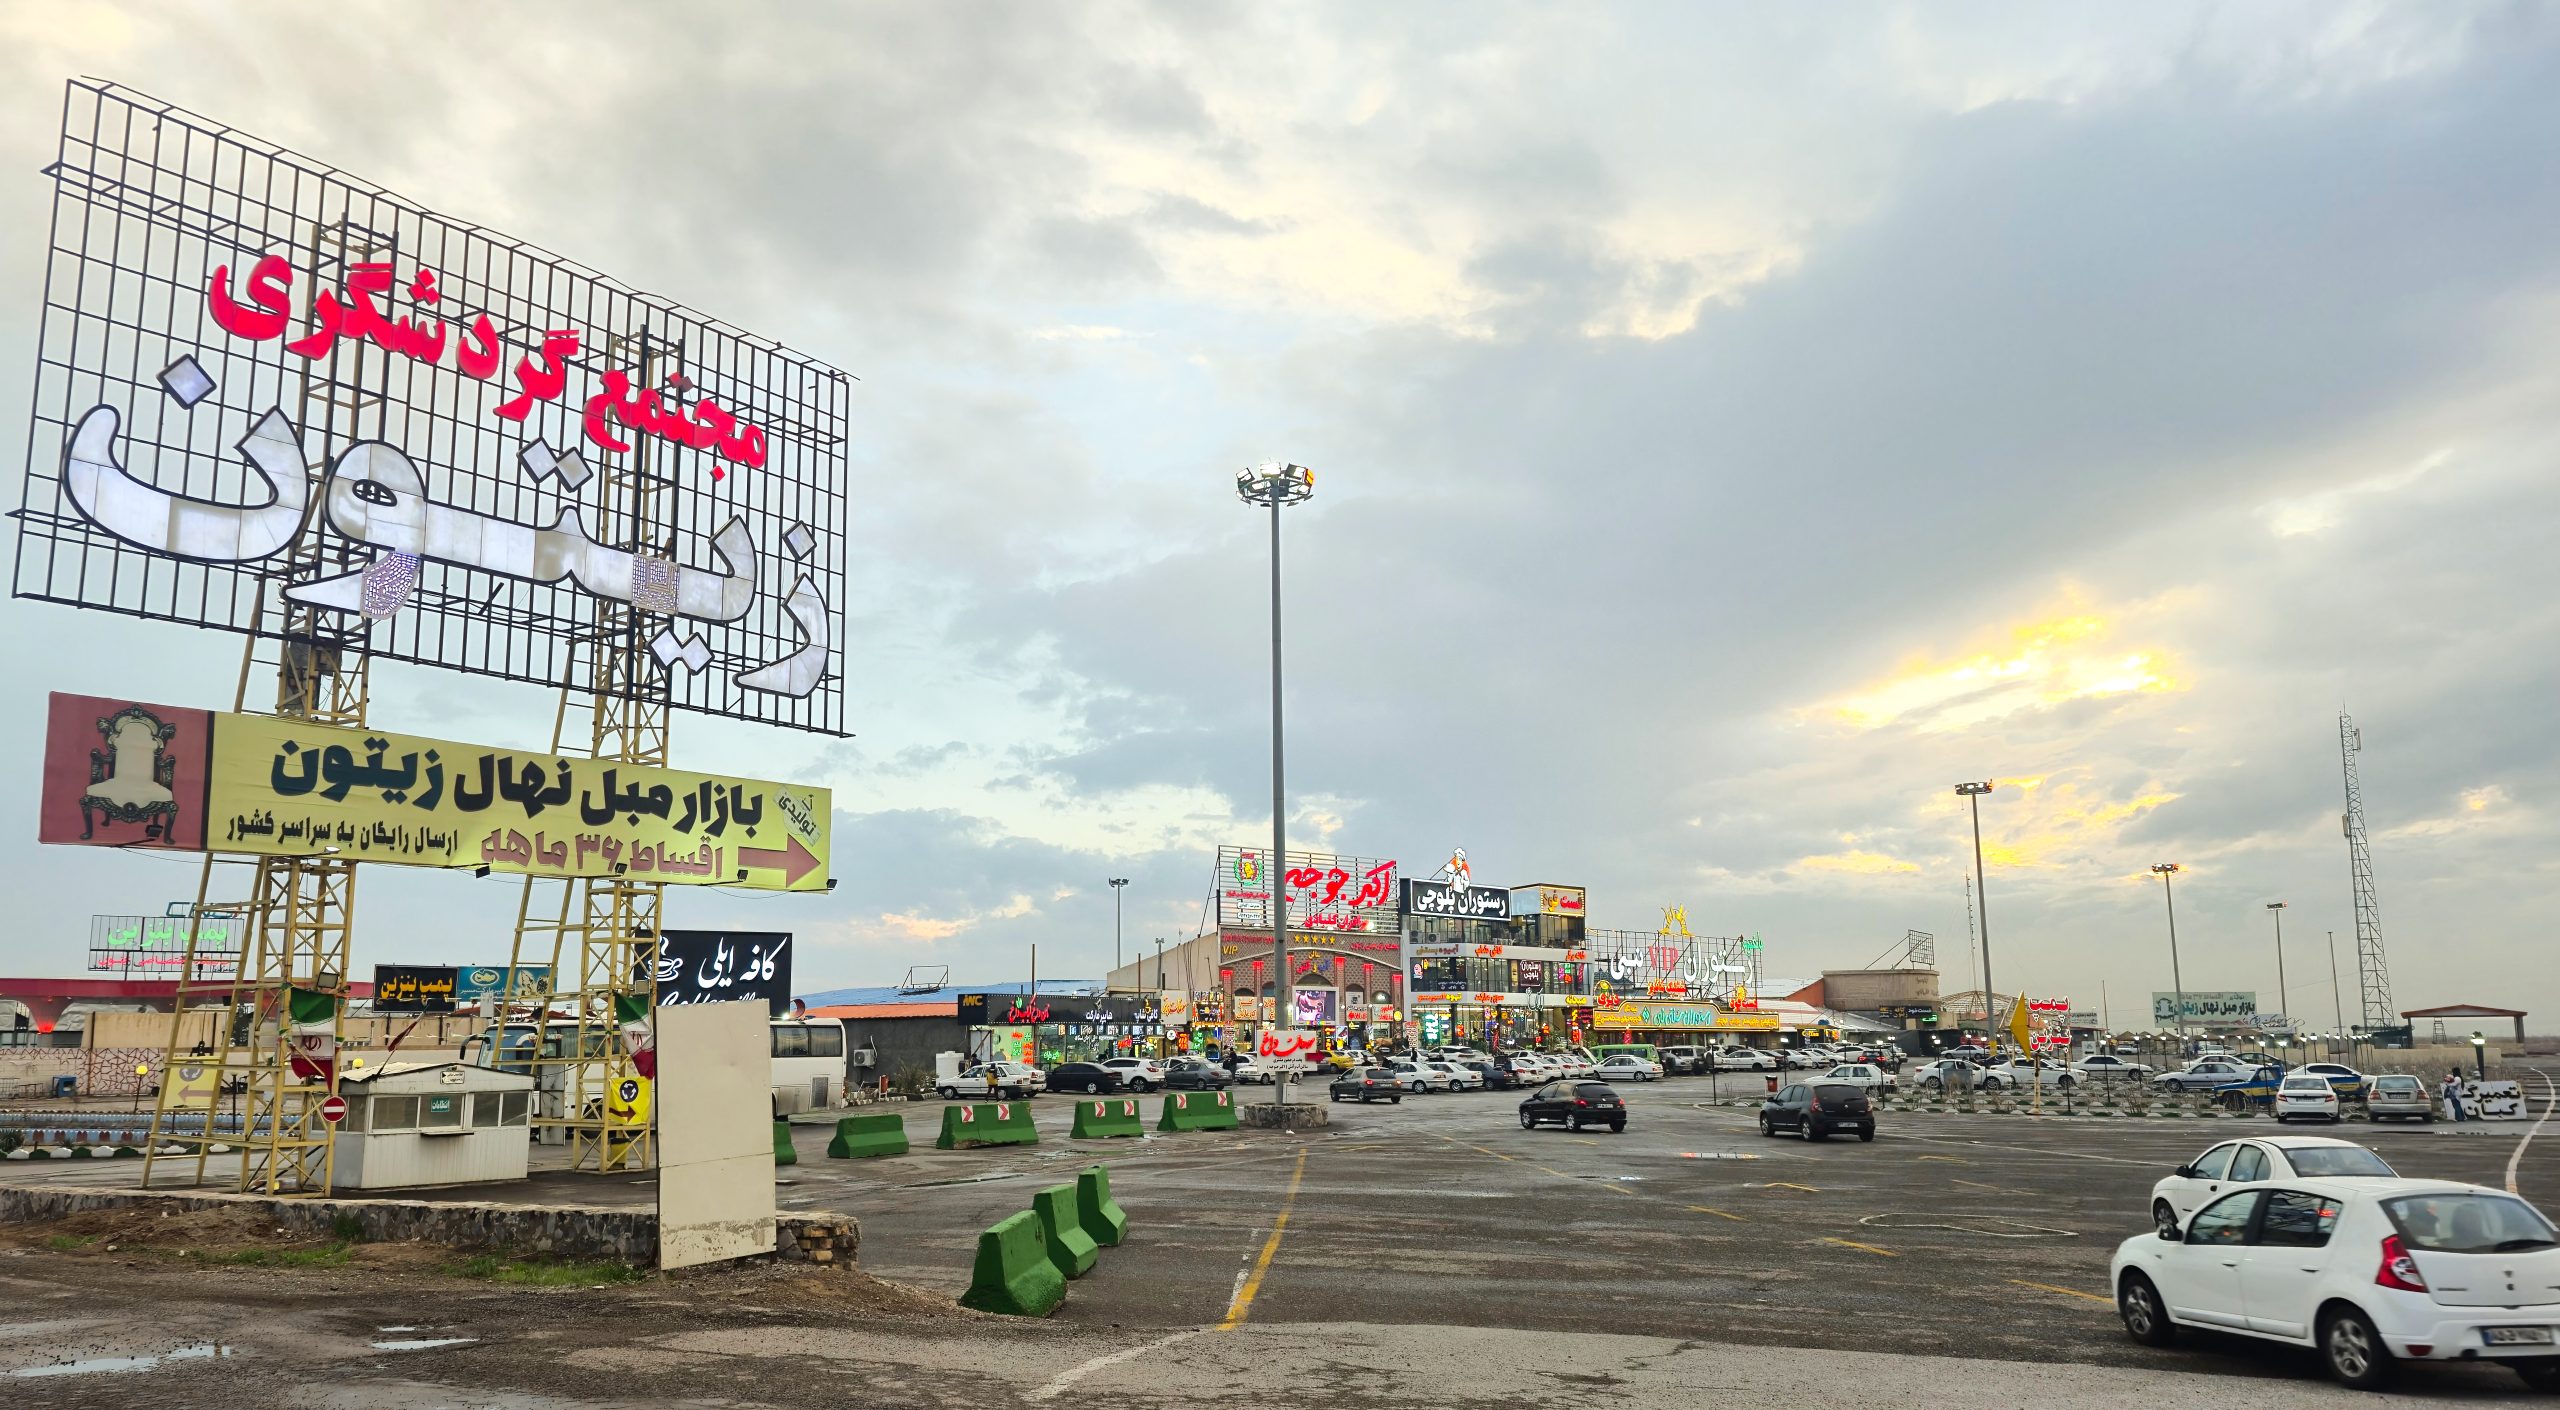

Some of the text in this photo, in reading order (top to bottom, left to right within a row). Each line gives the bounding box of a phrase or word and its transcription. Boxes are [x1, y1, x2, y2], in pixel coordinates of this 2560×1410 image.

[208, 254, 768, 481] مجتمع گردشگری
[62, 354, 831, 699] زیتون
[271, 736, 763, 839] بازار مبل نهال زیتون
[778, 795, 817, 836] تولیدی
[226, 808, 458, 857] ارسال رایگان به سراسر کشور
[481, 828, 723, 879] اقساط ۳۶ ماهه
[1348, 860, 1397, 907] اکبر
[1457, 888, 1506, 916] رستوران
[1543, 889, 1583, 912] فست فود
[108, 922, 228, 950] پمپ بنزین
[1222, 945, 1239, 955] VIP
[698, 936, 788, 988] کافه ایلی
[1648, 946, 1679, 971] VIP
[1684, 941, 1753, 984] رستوران
[380, 975, 453, 1005] پمپ بنزین
[2029, 996, 2069, 1024] پمپ
[2199, 1001, 2219, 1015] نهال
[2220, 1002, 2238, 1015] مبل
[2238, 1002, 2256, 1015] بازار
[1260, 1031, 1279, 1057] داغ
[2029, 1026, 2072, 1053] بنزین
